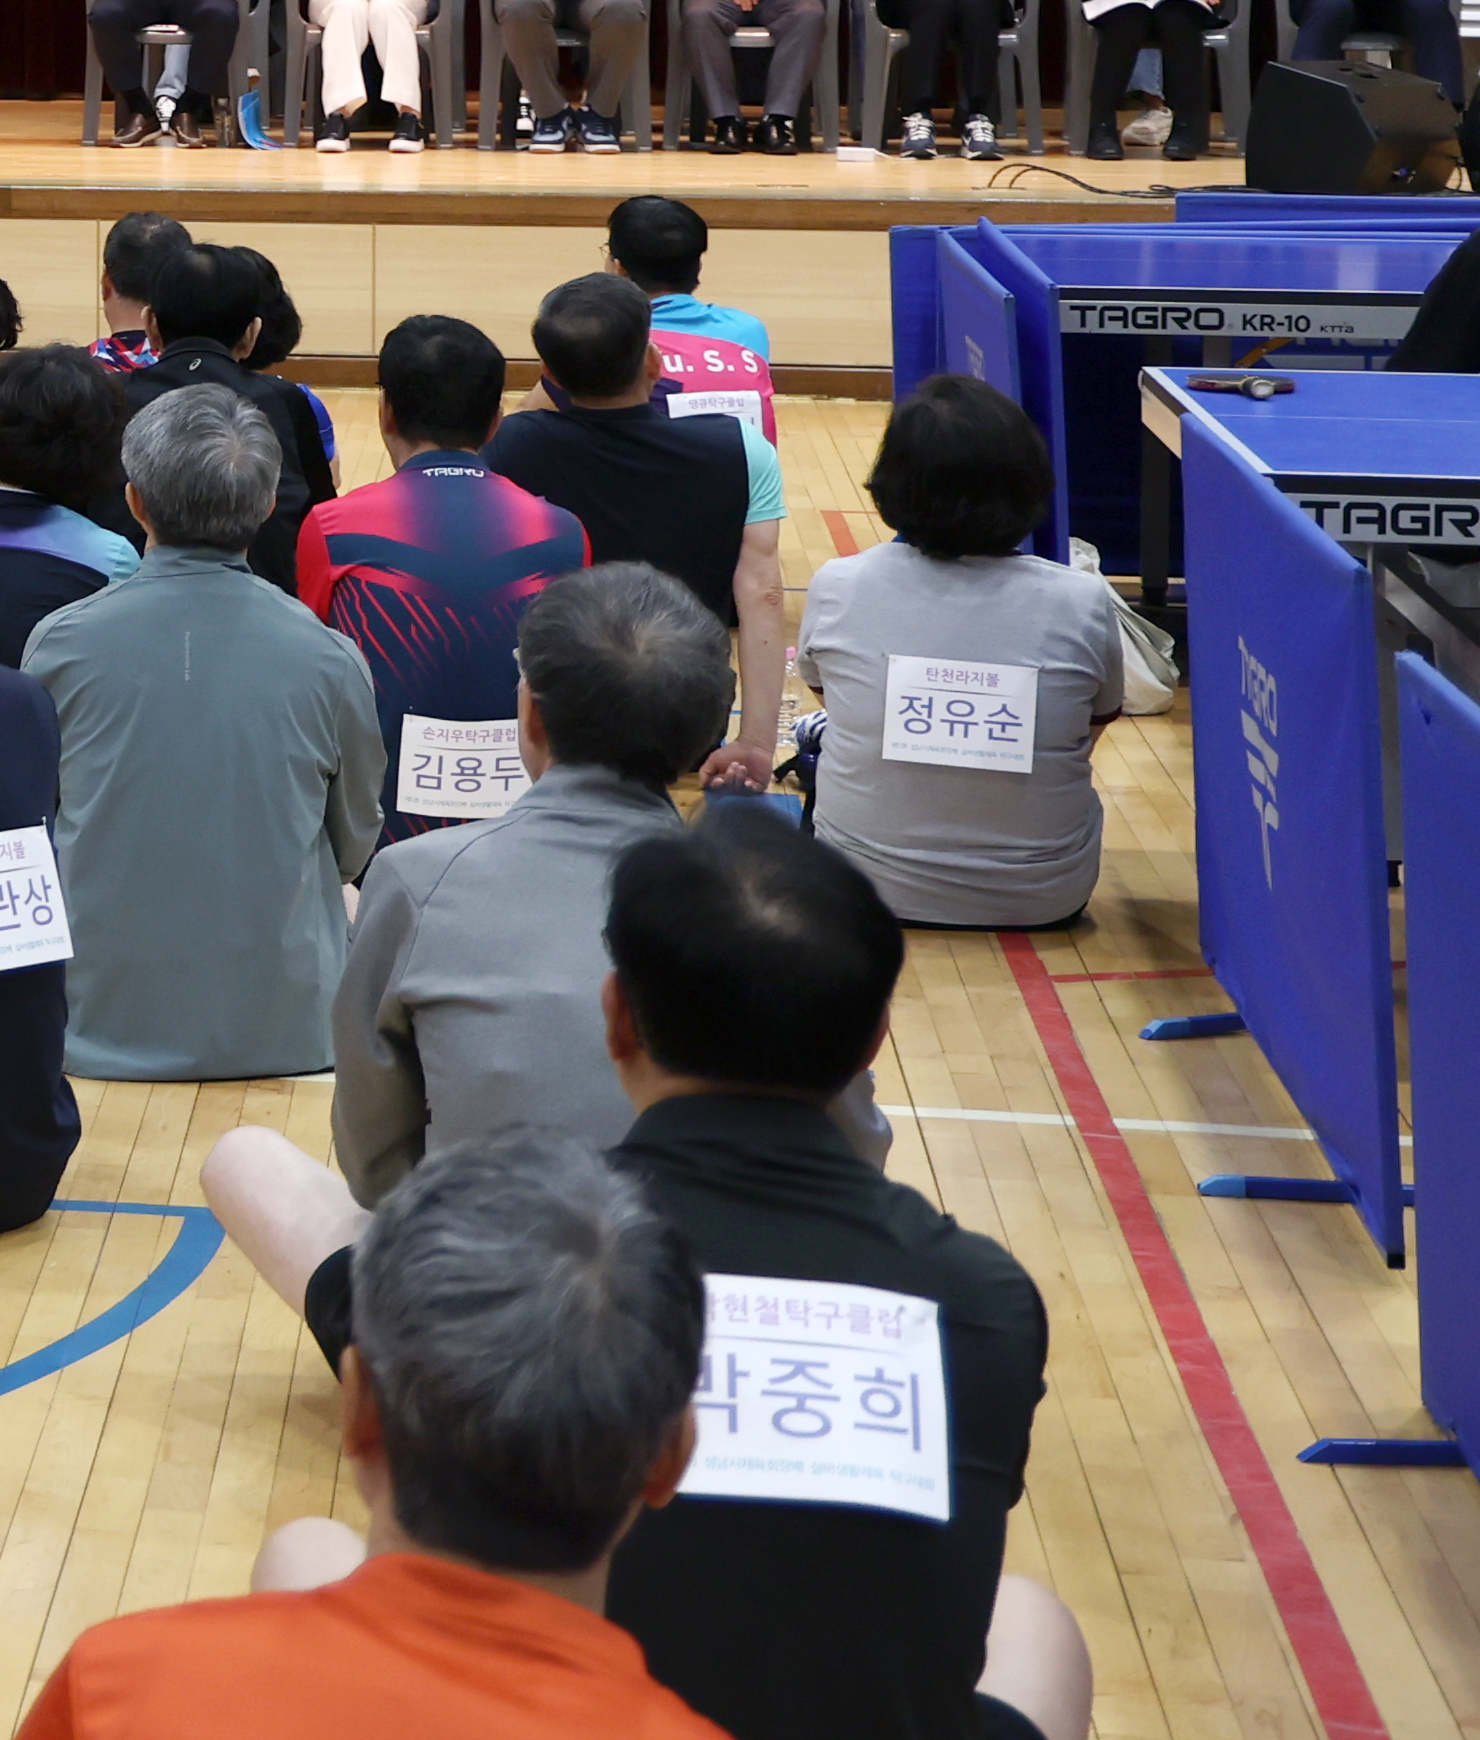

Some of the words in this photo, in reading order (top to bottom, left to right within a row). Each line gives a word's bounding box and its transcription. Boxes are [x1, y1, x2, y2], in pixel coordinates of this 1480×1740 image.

[1069, 305, 1224, 331] TAGRO
[1242, 313, 1311, 333] KR-10
[703, 349, 735, 372] S.
[926, 667, 1000, 688] 탄천라지볼
[898, 696, 1023, 743] 정유순
[422, 726, 516, 744] 손지우탁구클럽
[412, 753, 525, 793] 김용두
